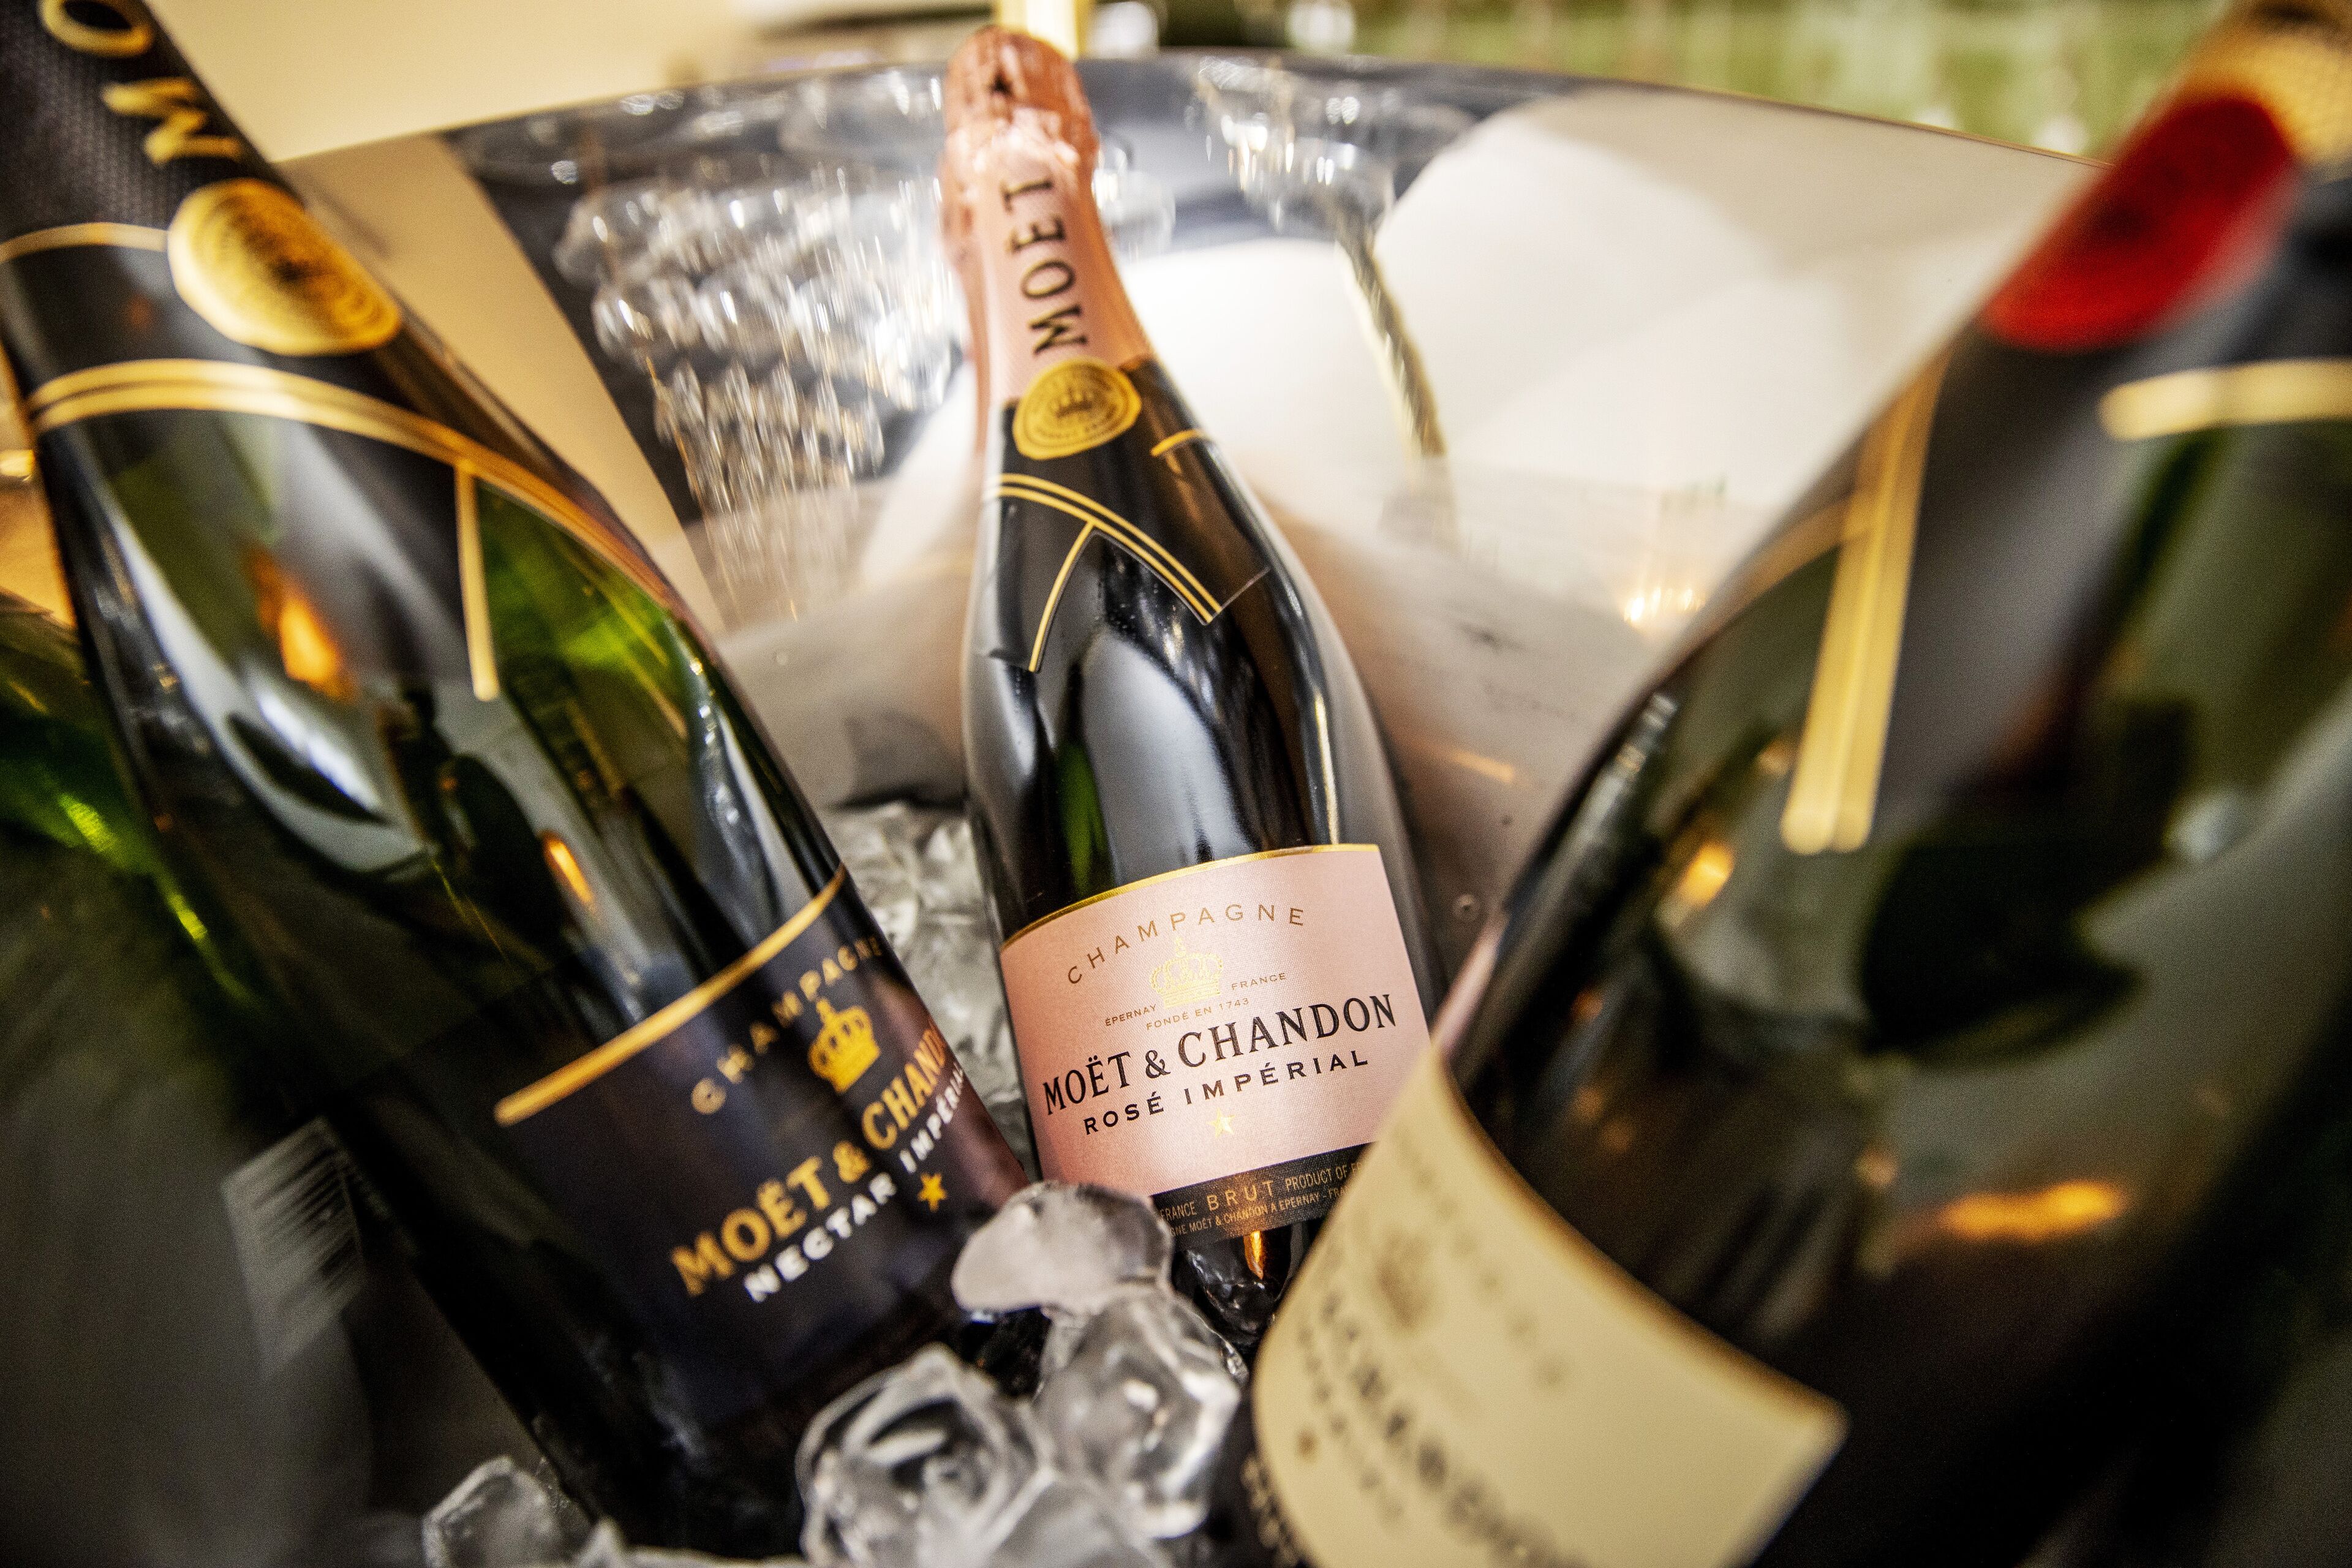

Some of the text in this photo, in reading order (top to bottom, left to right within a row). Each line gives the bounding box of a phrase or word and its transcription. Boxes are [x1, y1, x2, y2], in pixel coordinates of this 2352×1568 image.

[1067, 903, 1305, 985] CHAMPAGNE
[691, 935, 883, 1115] CHAMPAGNE
[1104, 972, 1287, 1027] ÉPERNAY FRANCE
[1145, 997, 1250, 1030] FONDÉ EN 1743
[1042, 993, 1397, 1115] MOËT & CHANDON
[1084, 1050, 1369, 1136] ROSÉ IMPÉRIAL
[833, 1140, 872, 1185] &
[1207, 1180, 1274, 1212] BRUT
[1285, 1168, 1332, 1193] PRODUCT
[1335, 1164, 1348, 1180] OF
[744, 1172, 897, 1303] NECTAR
[1215, 1215, 1222, 1227] &
[1224, 1204, 1269, 1224] CHANDON
[1279, 1191, 1321, 1212] EPERNAY
[1329, 1186, 1351, 1199] FRA
